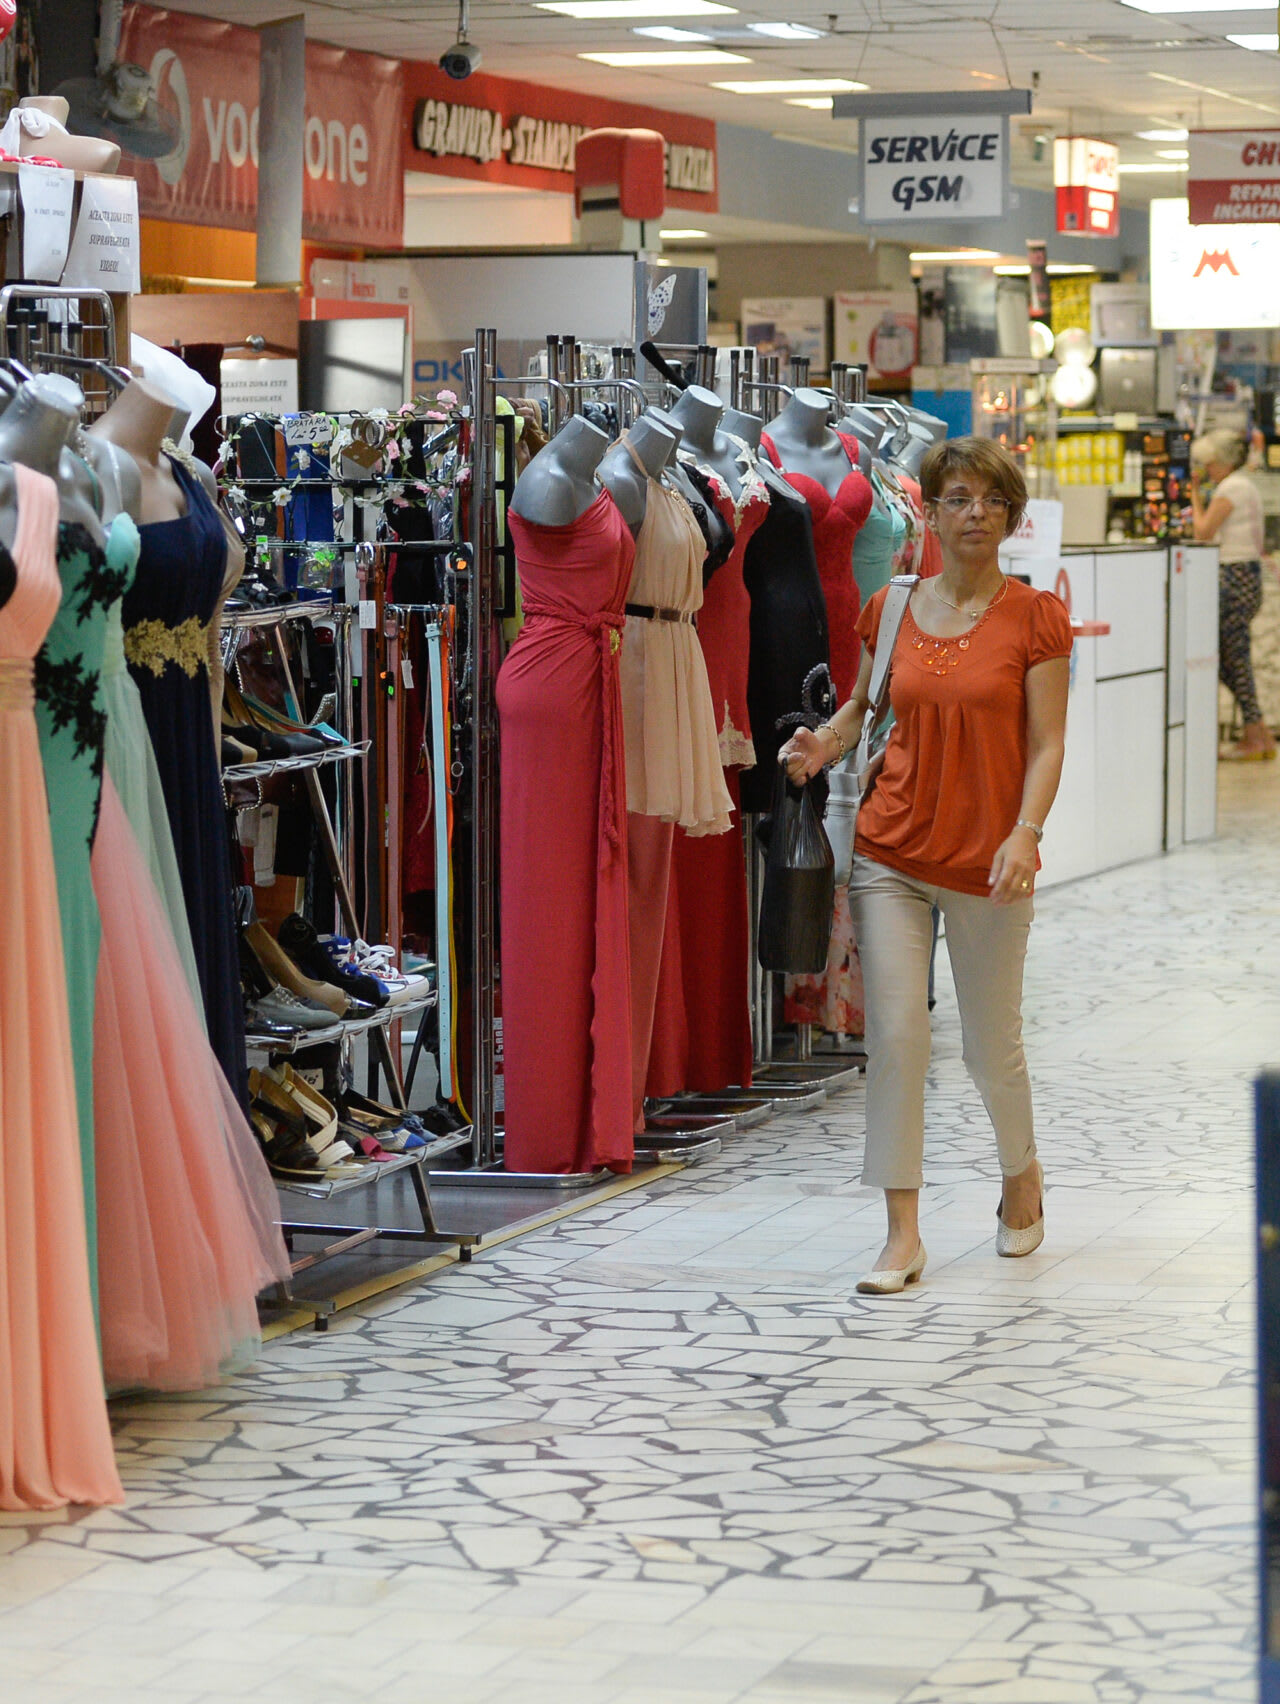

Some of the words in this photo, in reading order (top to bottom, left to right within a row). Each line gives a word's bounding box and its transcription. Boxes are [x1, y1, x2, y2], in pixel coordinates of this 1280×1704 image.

[420, 98, 502, 162] GRAVURA
[512, 115, 591, 172] STAMPI
[1241, 141, 1280, 167] CH
[891, 175, 964, 211] GSM
